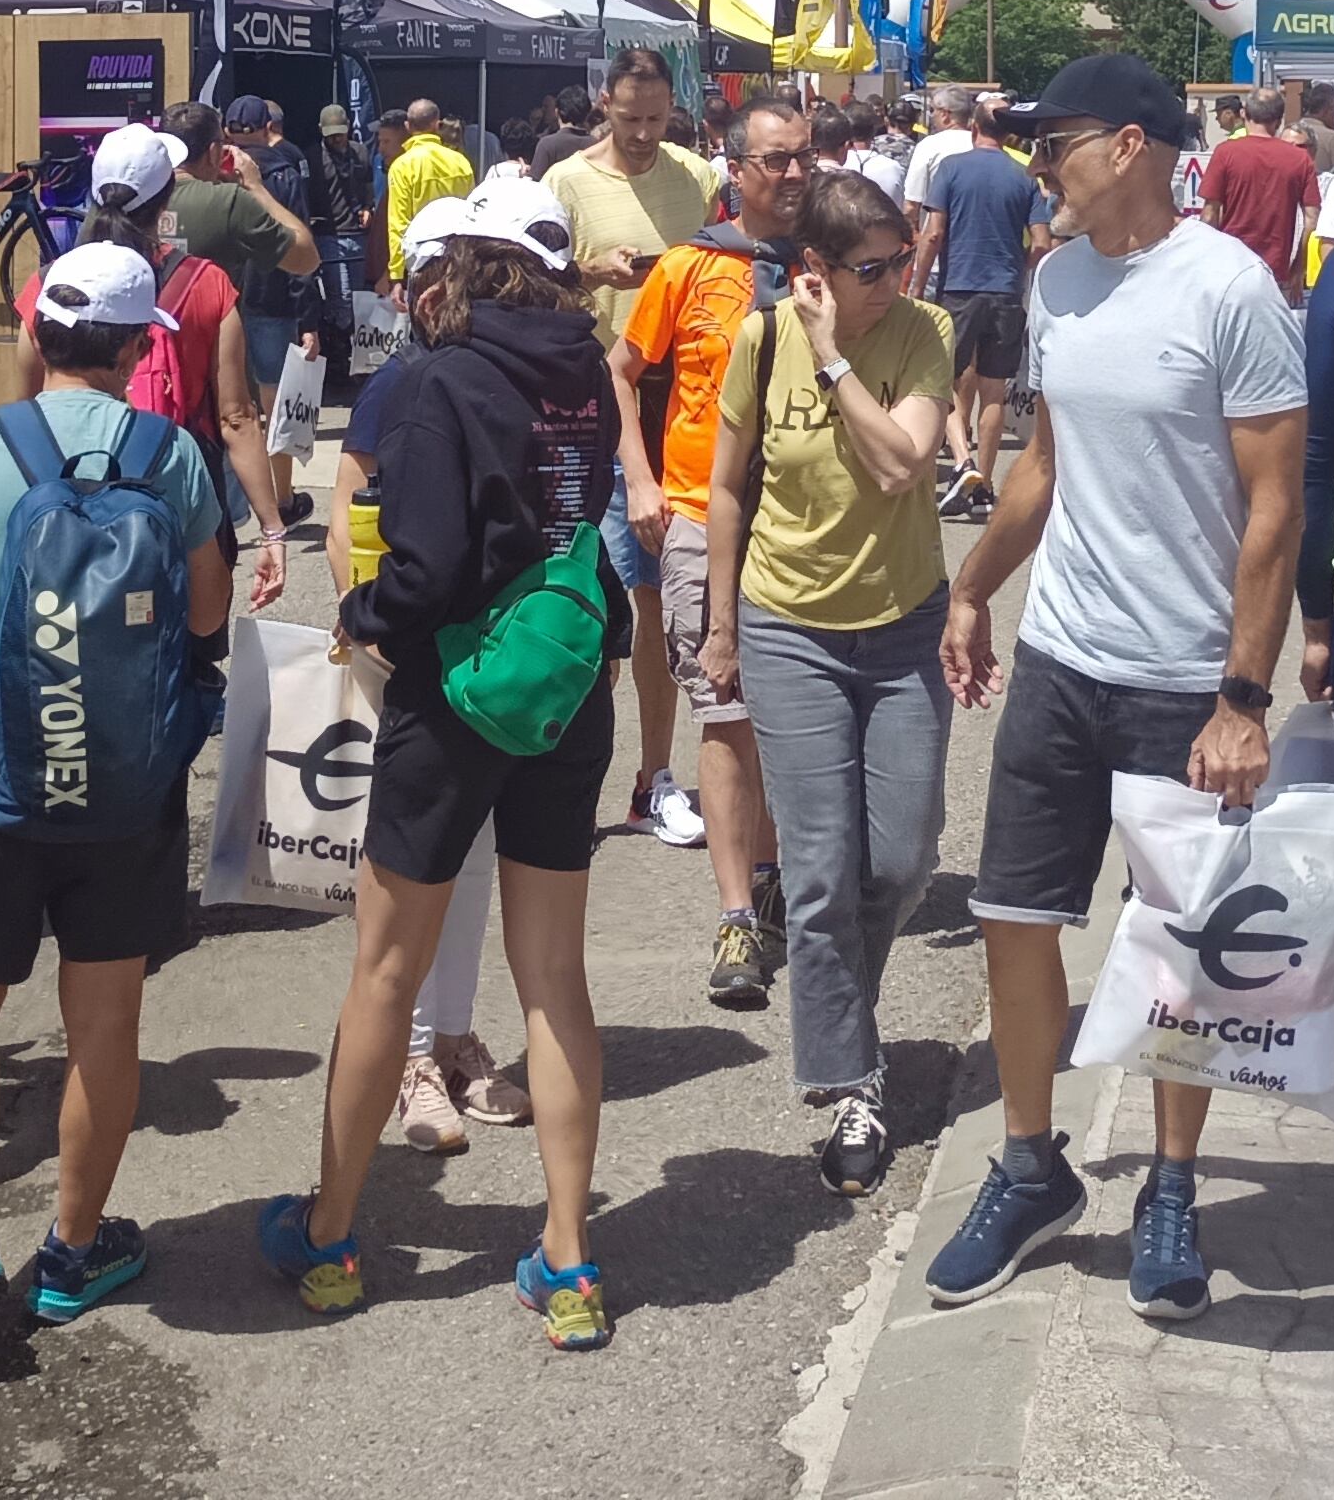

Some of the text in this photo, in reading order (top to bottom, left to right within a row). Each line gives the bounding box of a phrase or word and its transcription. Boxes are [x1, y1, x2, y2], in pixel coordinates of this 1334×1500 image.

[233, 12, 312, 48] KONE
[531, 31, 566, 60] FANTÉ
[86, 54, 154, 79] ROUVIDA
[40, 675, 88, 808] YONEX
[264, 879, 300, 893] BANCO
[301, 884, 319, 897] DEL
[324, 882, 356, 905] Vam
[1146, 998, 1296, 1053] iberCaja
[1139, 1051, 1154, 1061] EL
[1155, 1052, 1199, 1072] BANCO
[1201, 1066, 1225, 1079] DEL
